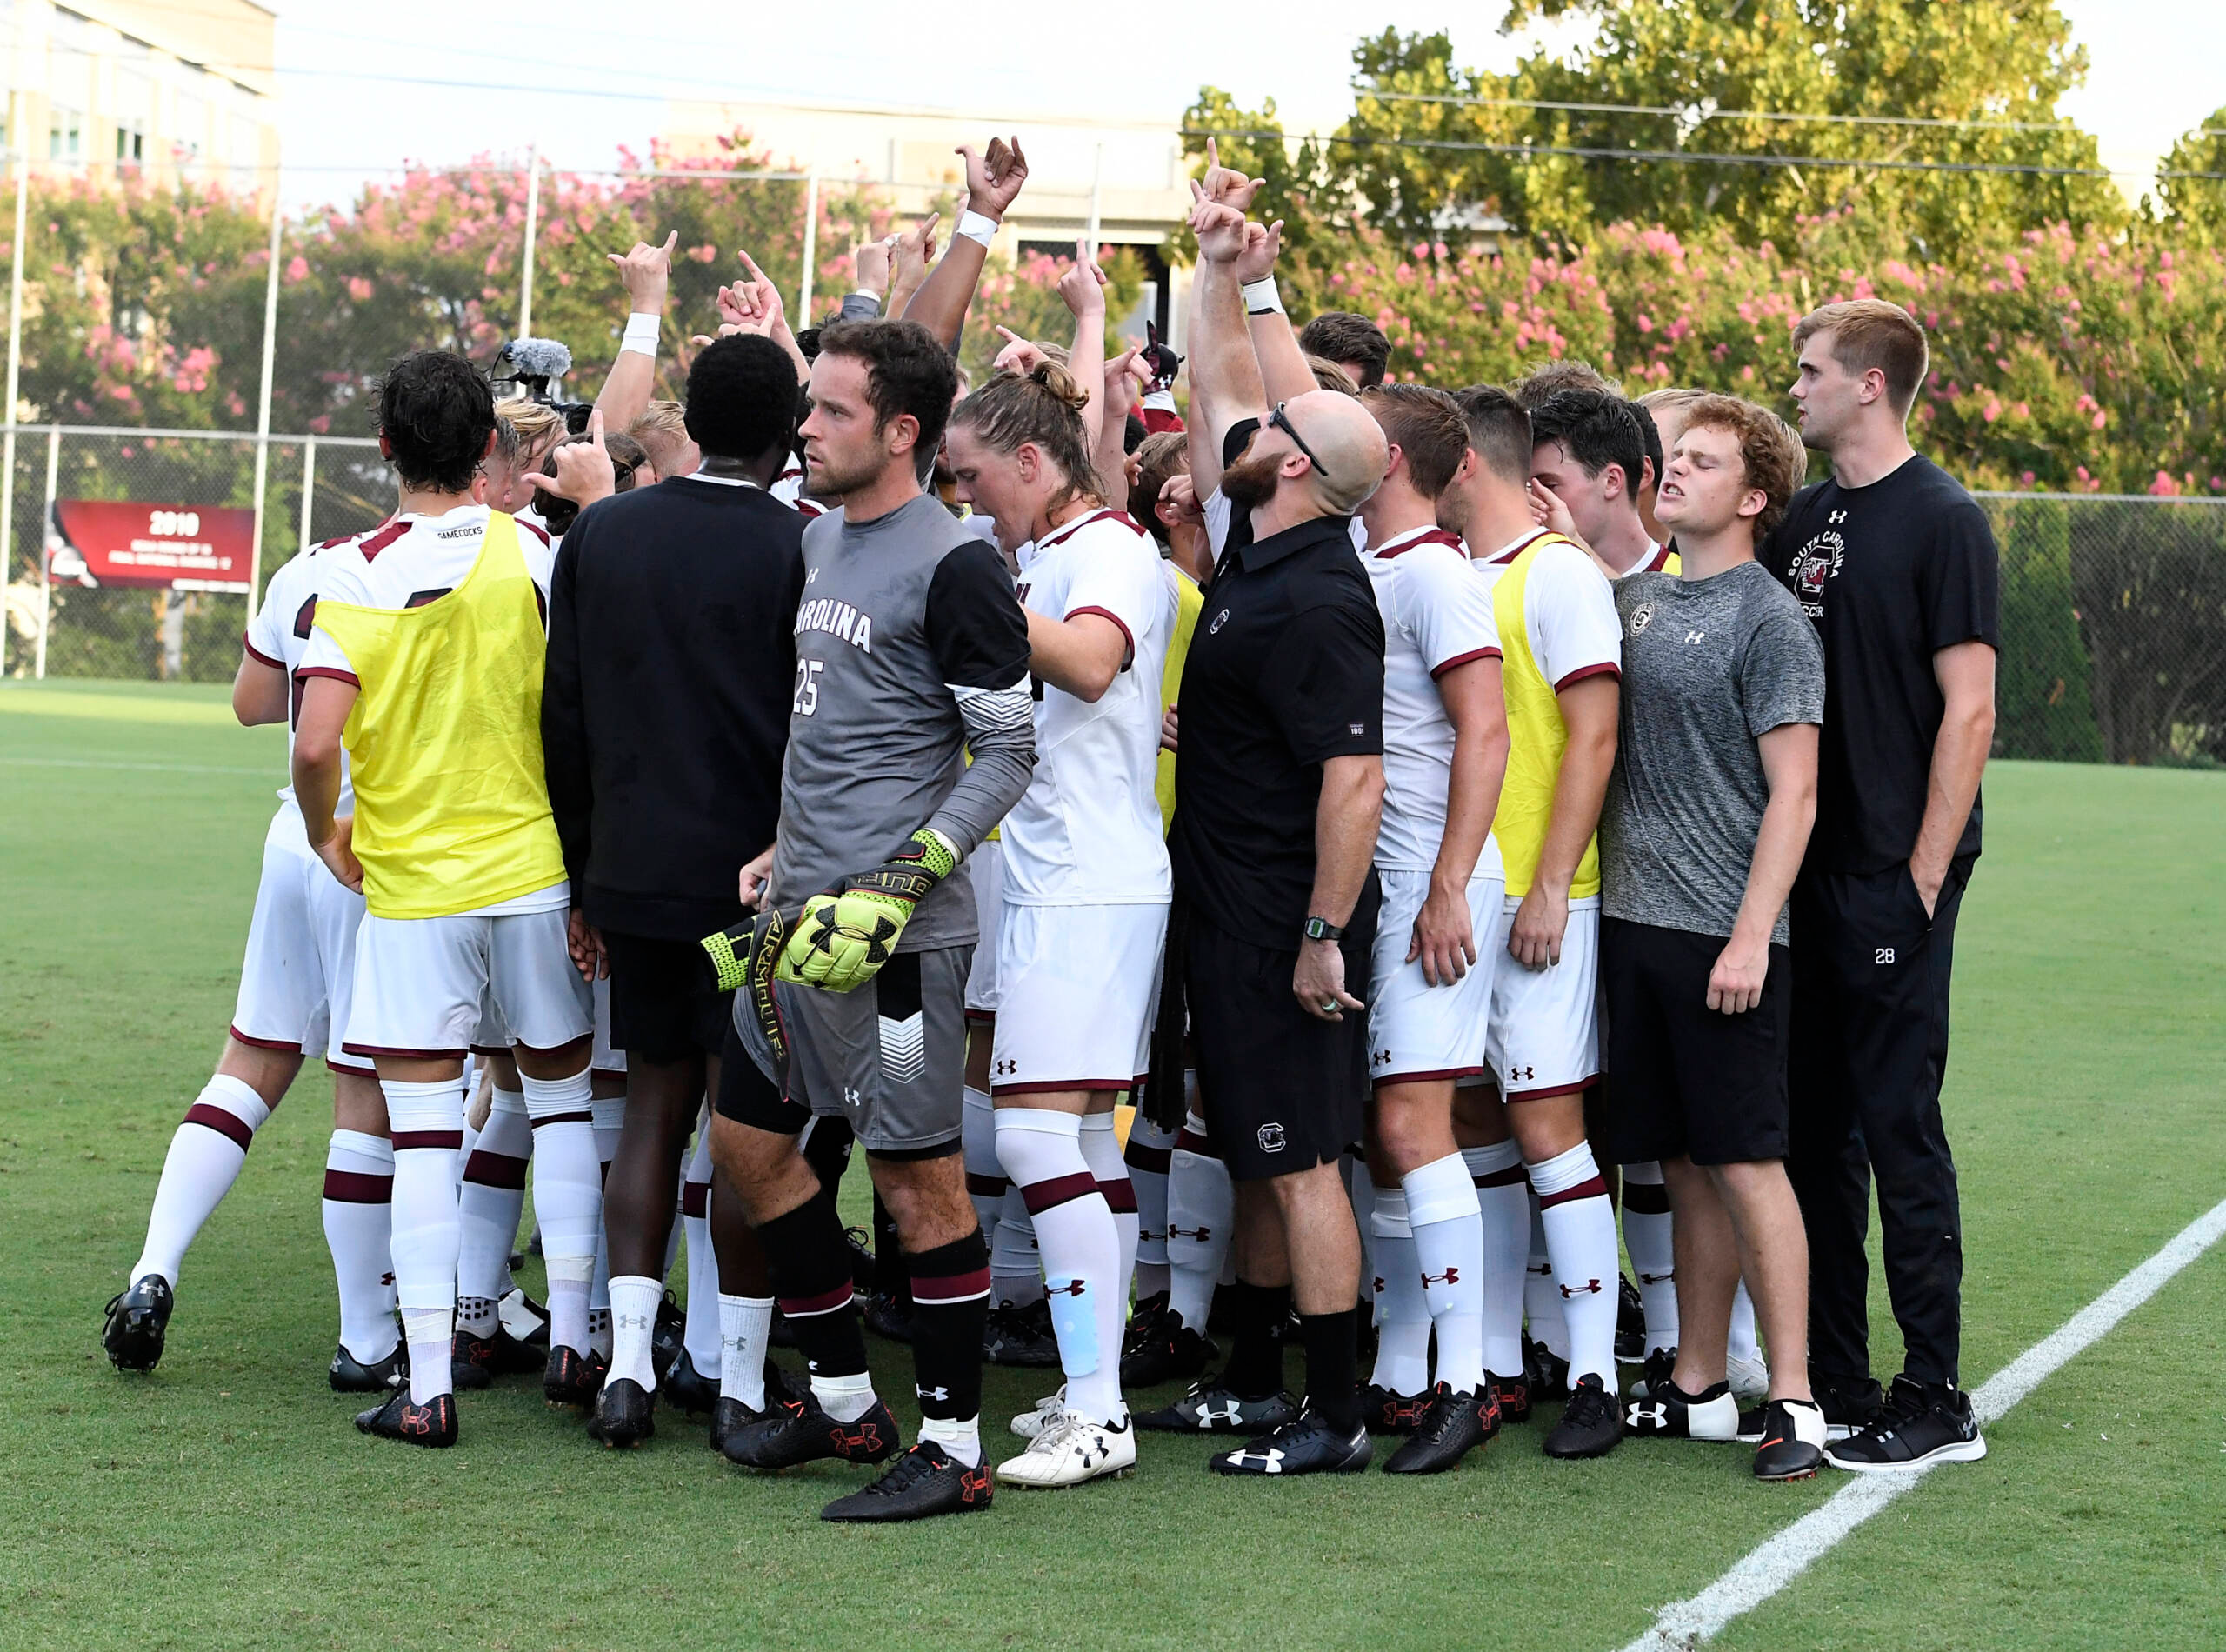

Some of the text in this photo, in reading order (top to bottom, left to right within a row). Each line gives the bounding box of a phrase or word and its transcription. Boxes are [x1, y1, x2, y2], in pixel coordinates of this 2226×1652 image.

[437, 526, 483, 540] GAMECOCKS
[1788, 530, 1845, 578] SOUTH CAROLINA
[792, 597, 873, 655] AROLINA
[1801, 604, 1824, 617] CCER
[792, 657, 825, 717] 25
[1875, 947, 1896, 964] 28
